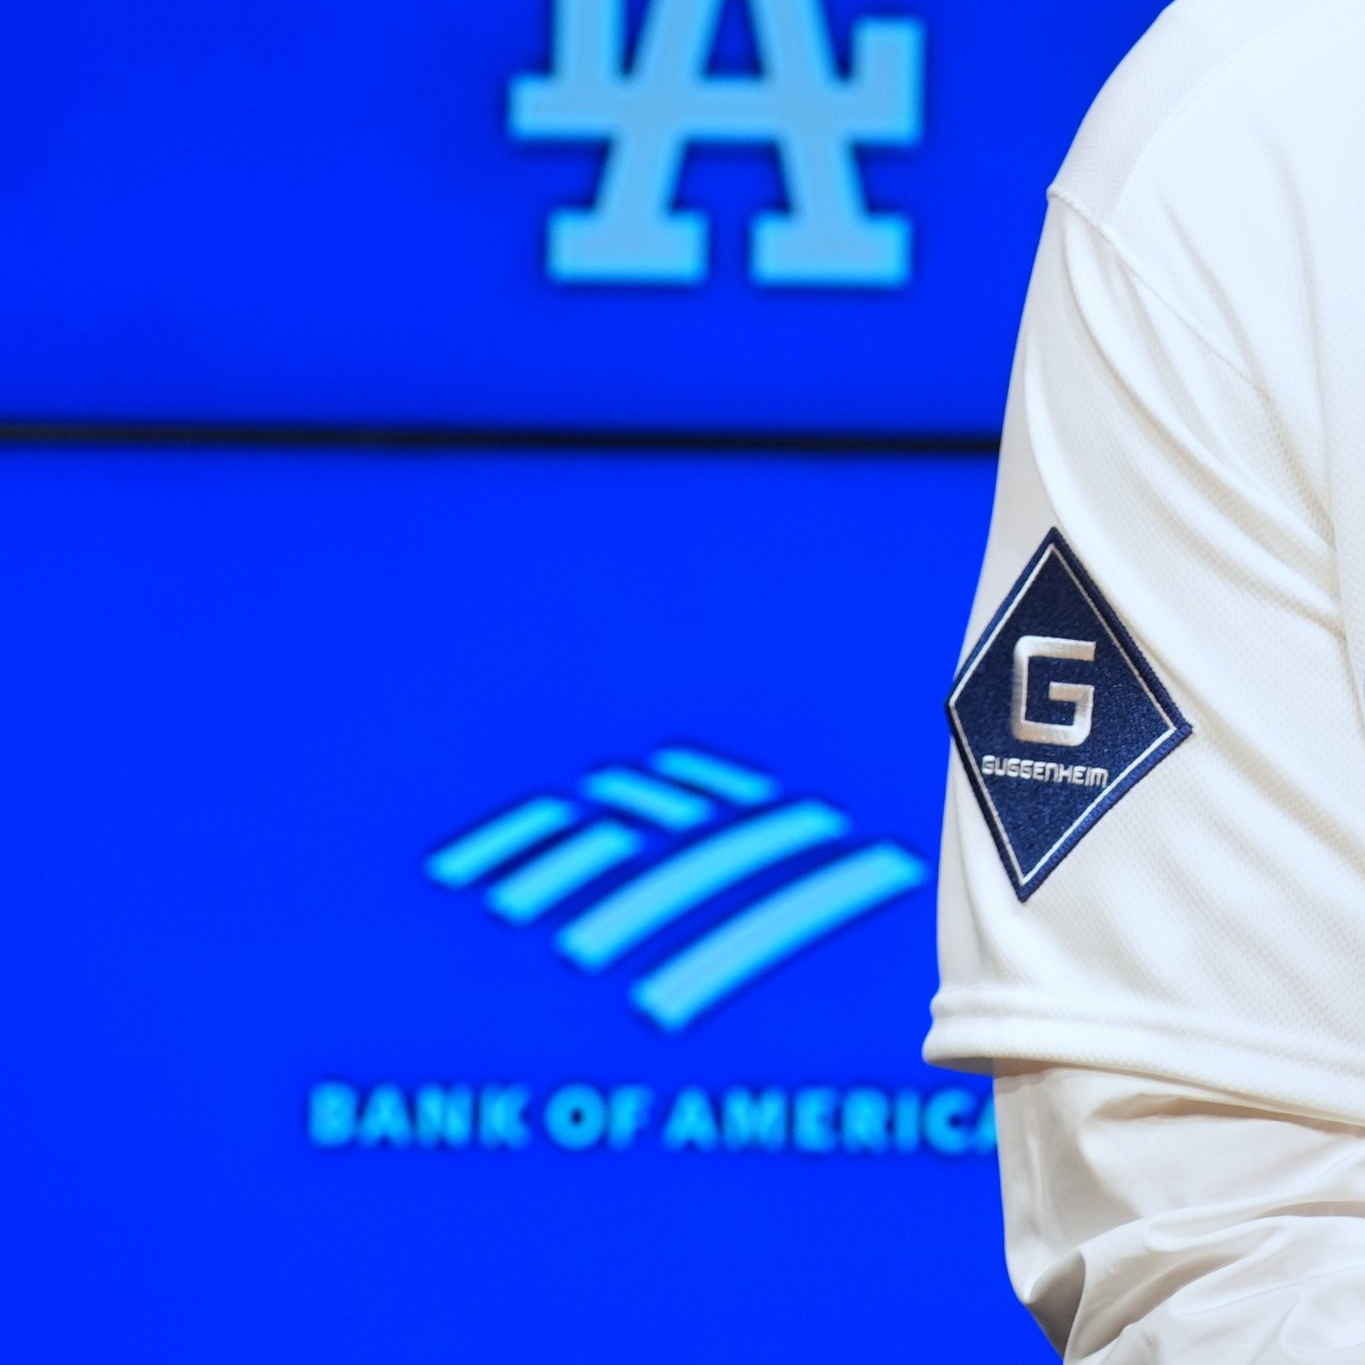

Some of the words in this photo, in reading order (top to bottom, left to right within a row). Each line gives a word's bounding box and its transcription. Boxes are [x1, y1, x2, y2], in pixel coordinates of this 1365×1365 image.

[1011, 635, 1097, 748] G
[981, 755, 1109, 788] GUGGENHEIM
[308, 1081, 530, 1150] BANK
[544, 1084, 652, 1152] OF
